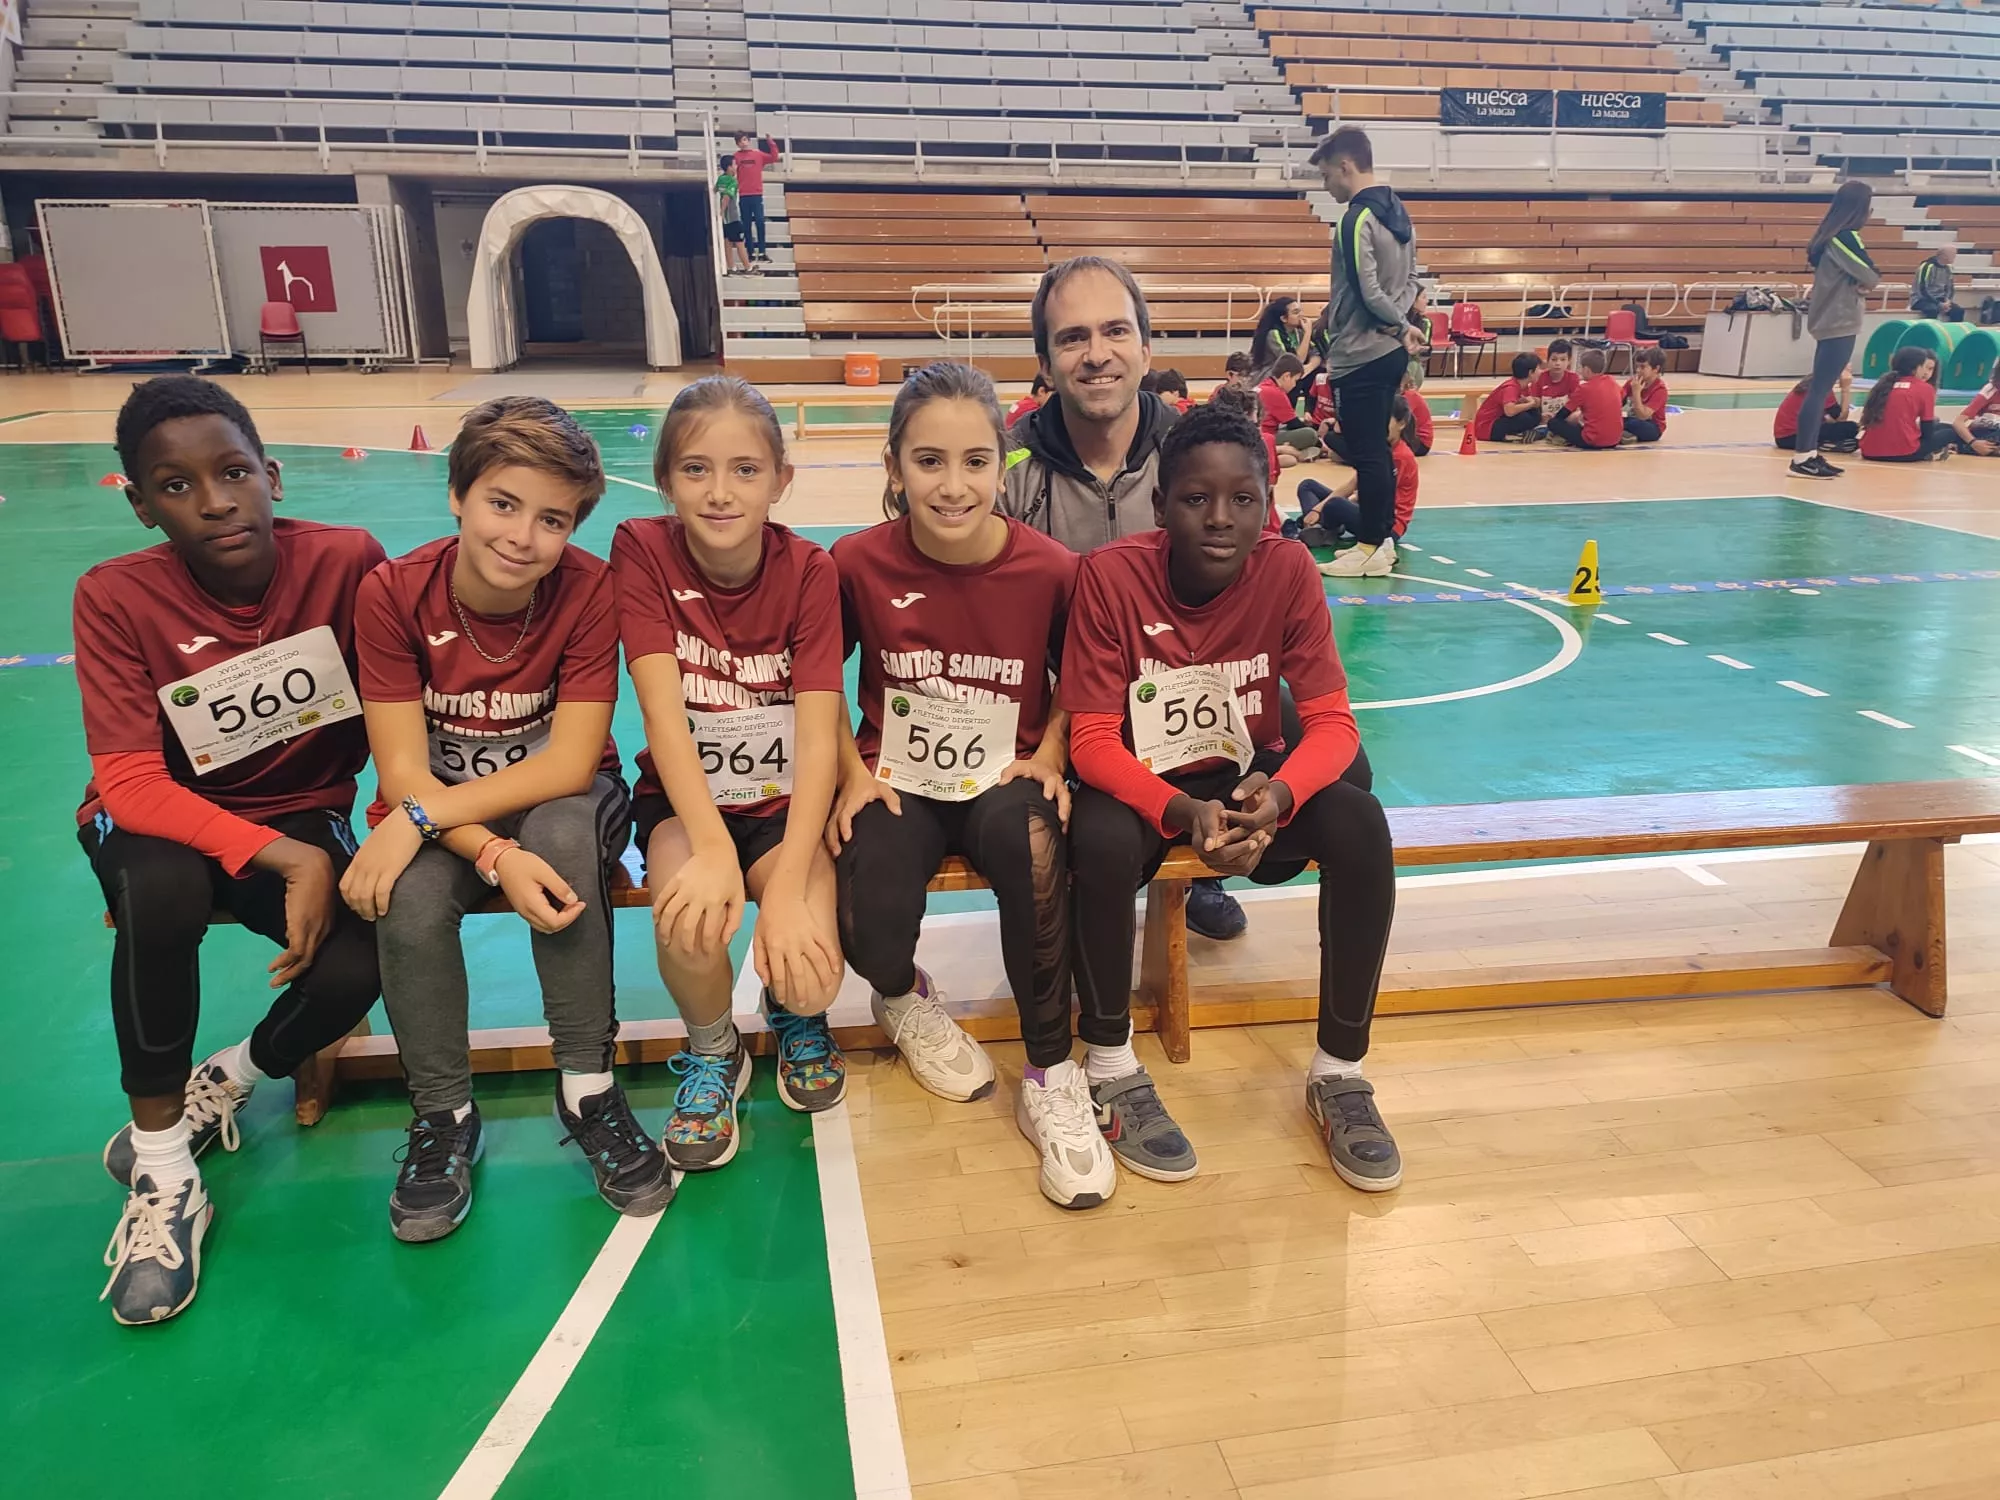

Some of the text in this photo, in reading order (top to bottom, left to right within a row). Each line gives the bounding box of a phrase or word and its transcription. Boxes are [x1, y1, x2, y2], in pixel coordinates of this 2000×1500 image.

[1574, 567, 1600, 594] 2
[203, 650, 300, 693] ATLETISMO DIVERTIDO
[218, 648, 276, 677] XVII TORNEO
[880, 649, 1025, 686] SANTOS SAMPER
[1175, 670, 1192, 681] XVII
[423, 681, 487, 719] ANTOS
[1159, 679, 1200, 692] ATLETISMO
[207, 667, 317, 734] 560
[928, 702, 976, 716] XVII TORNEO
[1164, 693, 1236, 737] 561
[697, 719, 784, 733] ATLETISMO DIVERTIDO
[716, 712, 766, 725] XVII TORNEO
[912, 708, 992, 726] ATLETISMO DIVERTIDO
[697, 736, 789, 775] 564
[907, 723, 986, 770] 566
